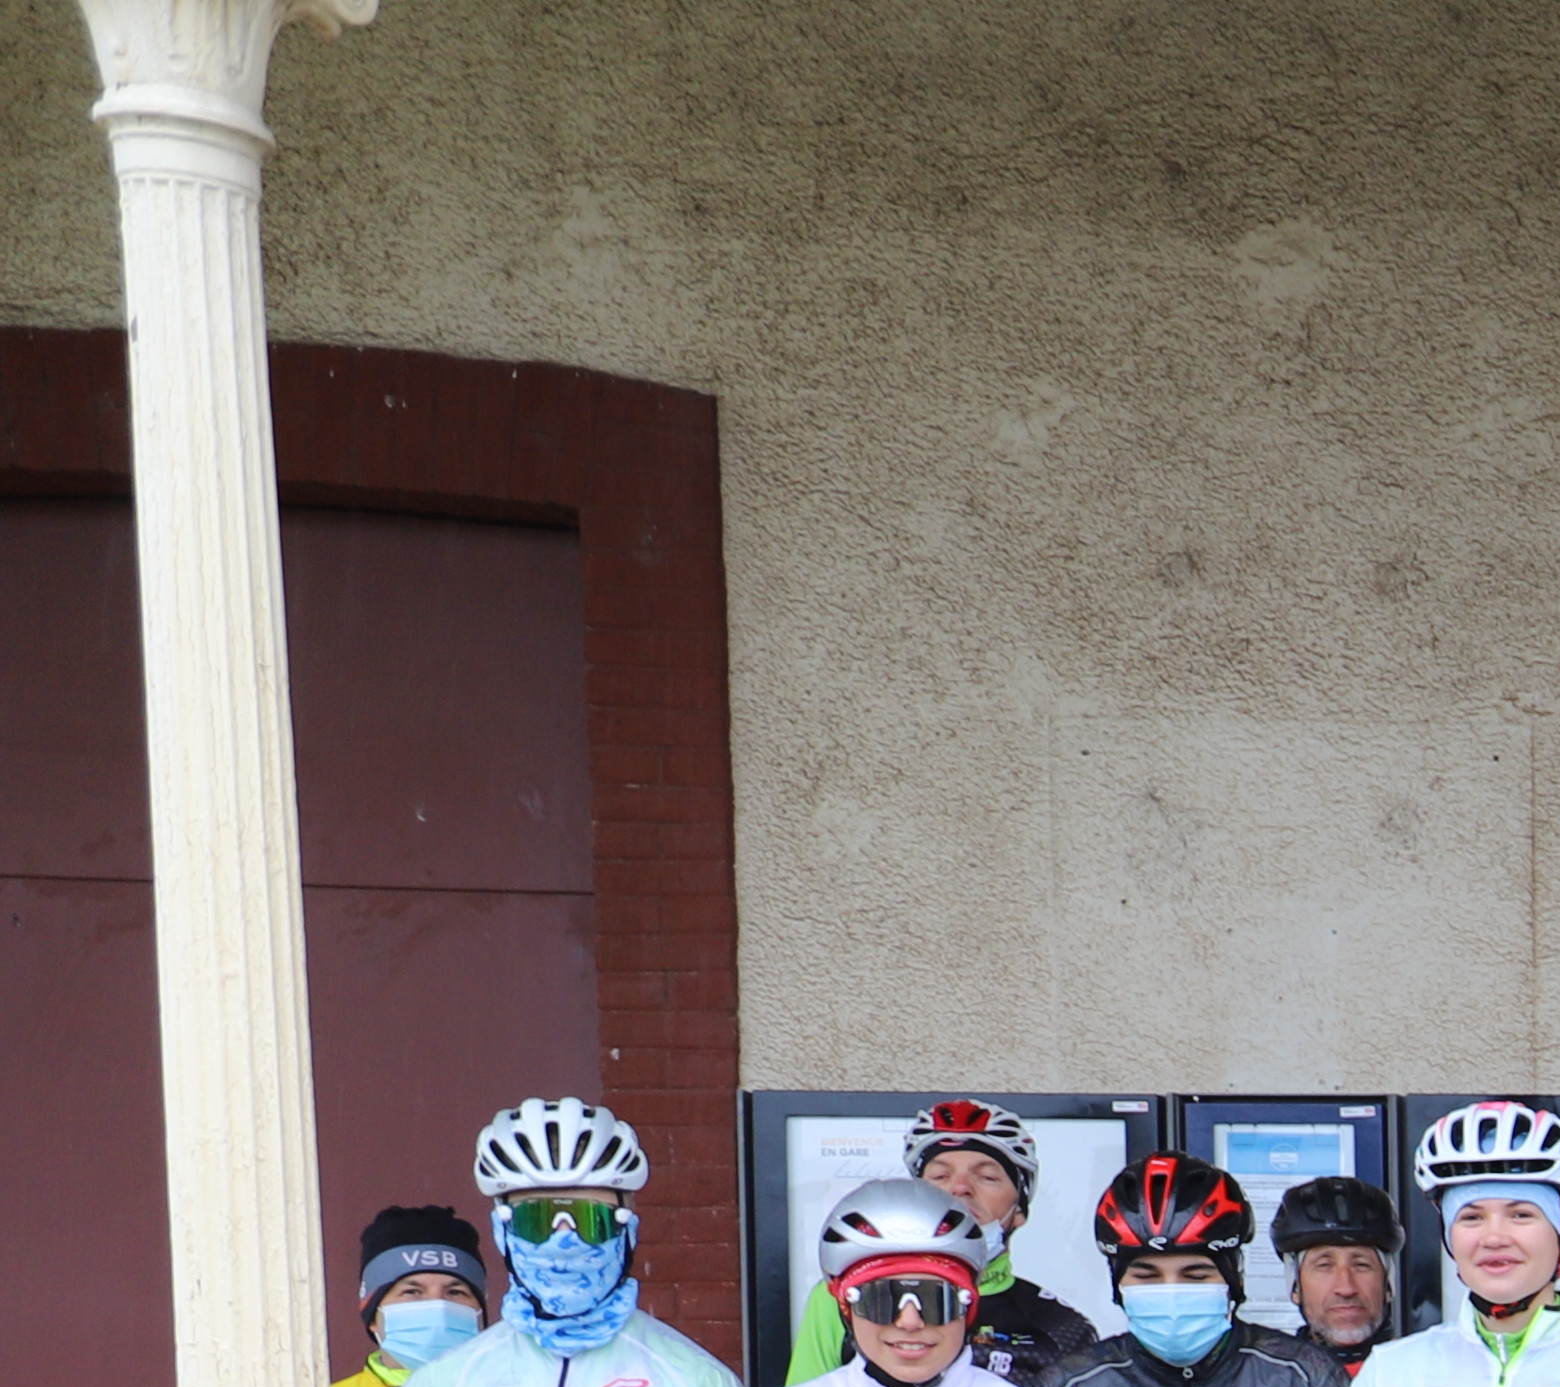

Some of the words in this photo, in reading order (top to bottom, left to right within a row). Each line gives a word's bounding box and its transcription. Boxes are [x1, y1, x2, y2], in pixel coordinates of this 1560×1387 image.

[821, 1138, 884, 1147] BIENVENUE
[821, 1148, 836, 1157] EN
[840, 1148, 870, 1157] GARE
[402, 1249, 459, 1269] VSB
